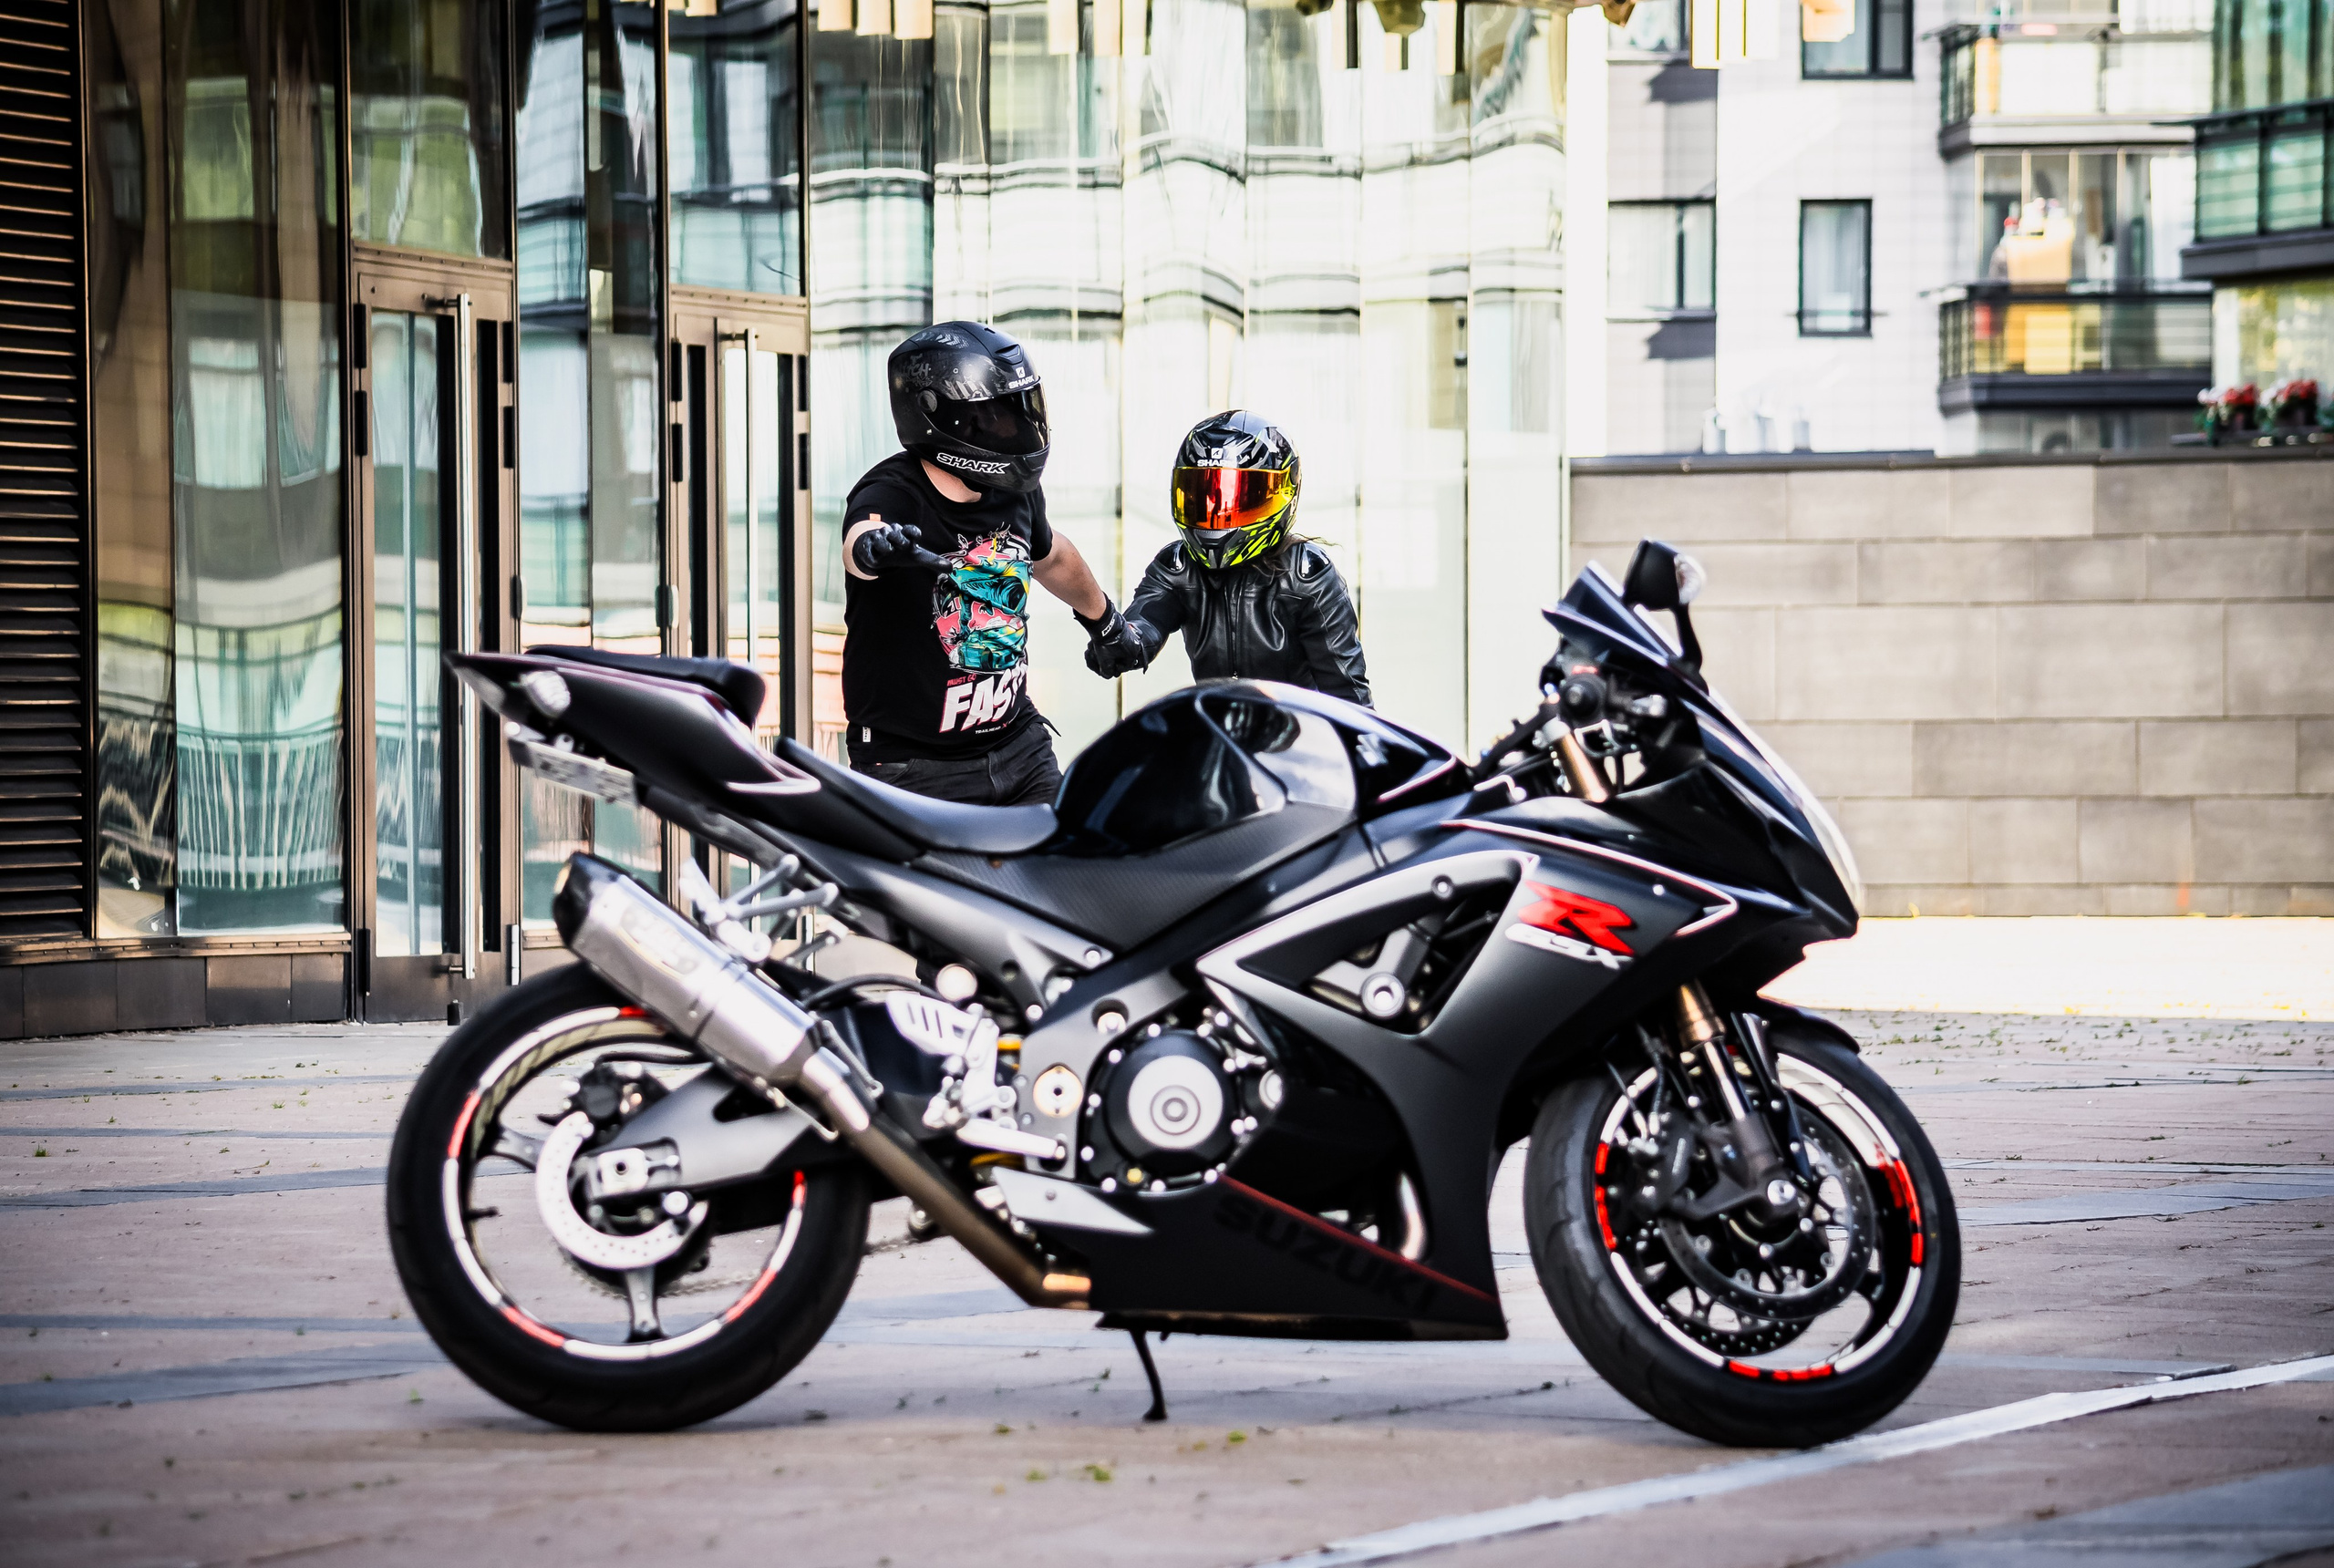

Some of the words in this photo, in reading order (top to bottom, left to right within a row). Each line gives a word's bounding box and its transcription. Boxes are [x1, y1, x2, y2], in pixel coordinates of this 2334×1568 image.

[1008, 375, 1035, 389] SHARK
[936, 453, 1011, 474] SHARK
[946, 676, 966, 686] MUST
[1518, 880, 1636, 956] R
[1213, 1193, 1439, 1313] SUZUKI
